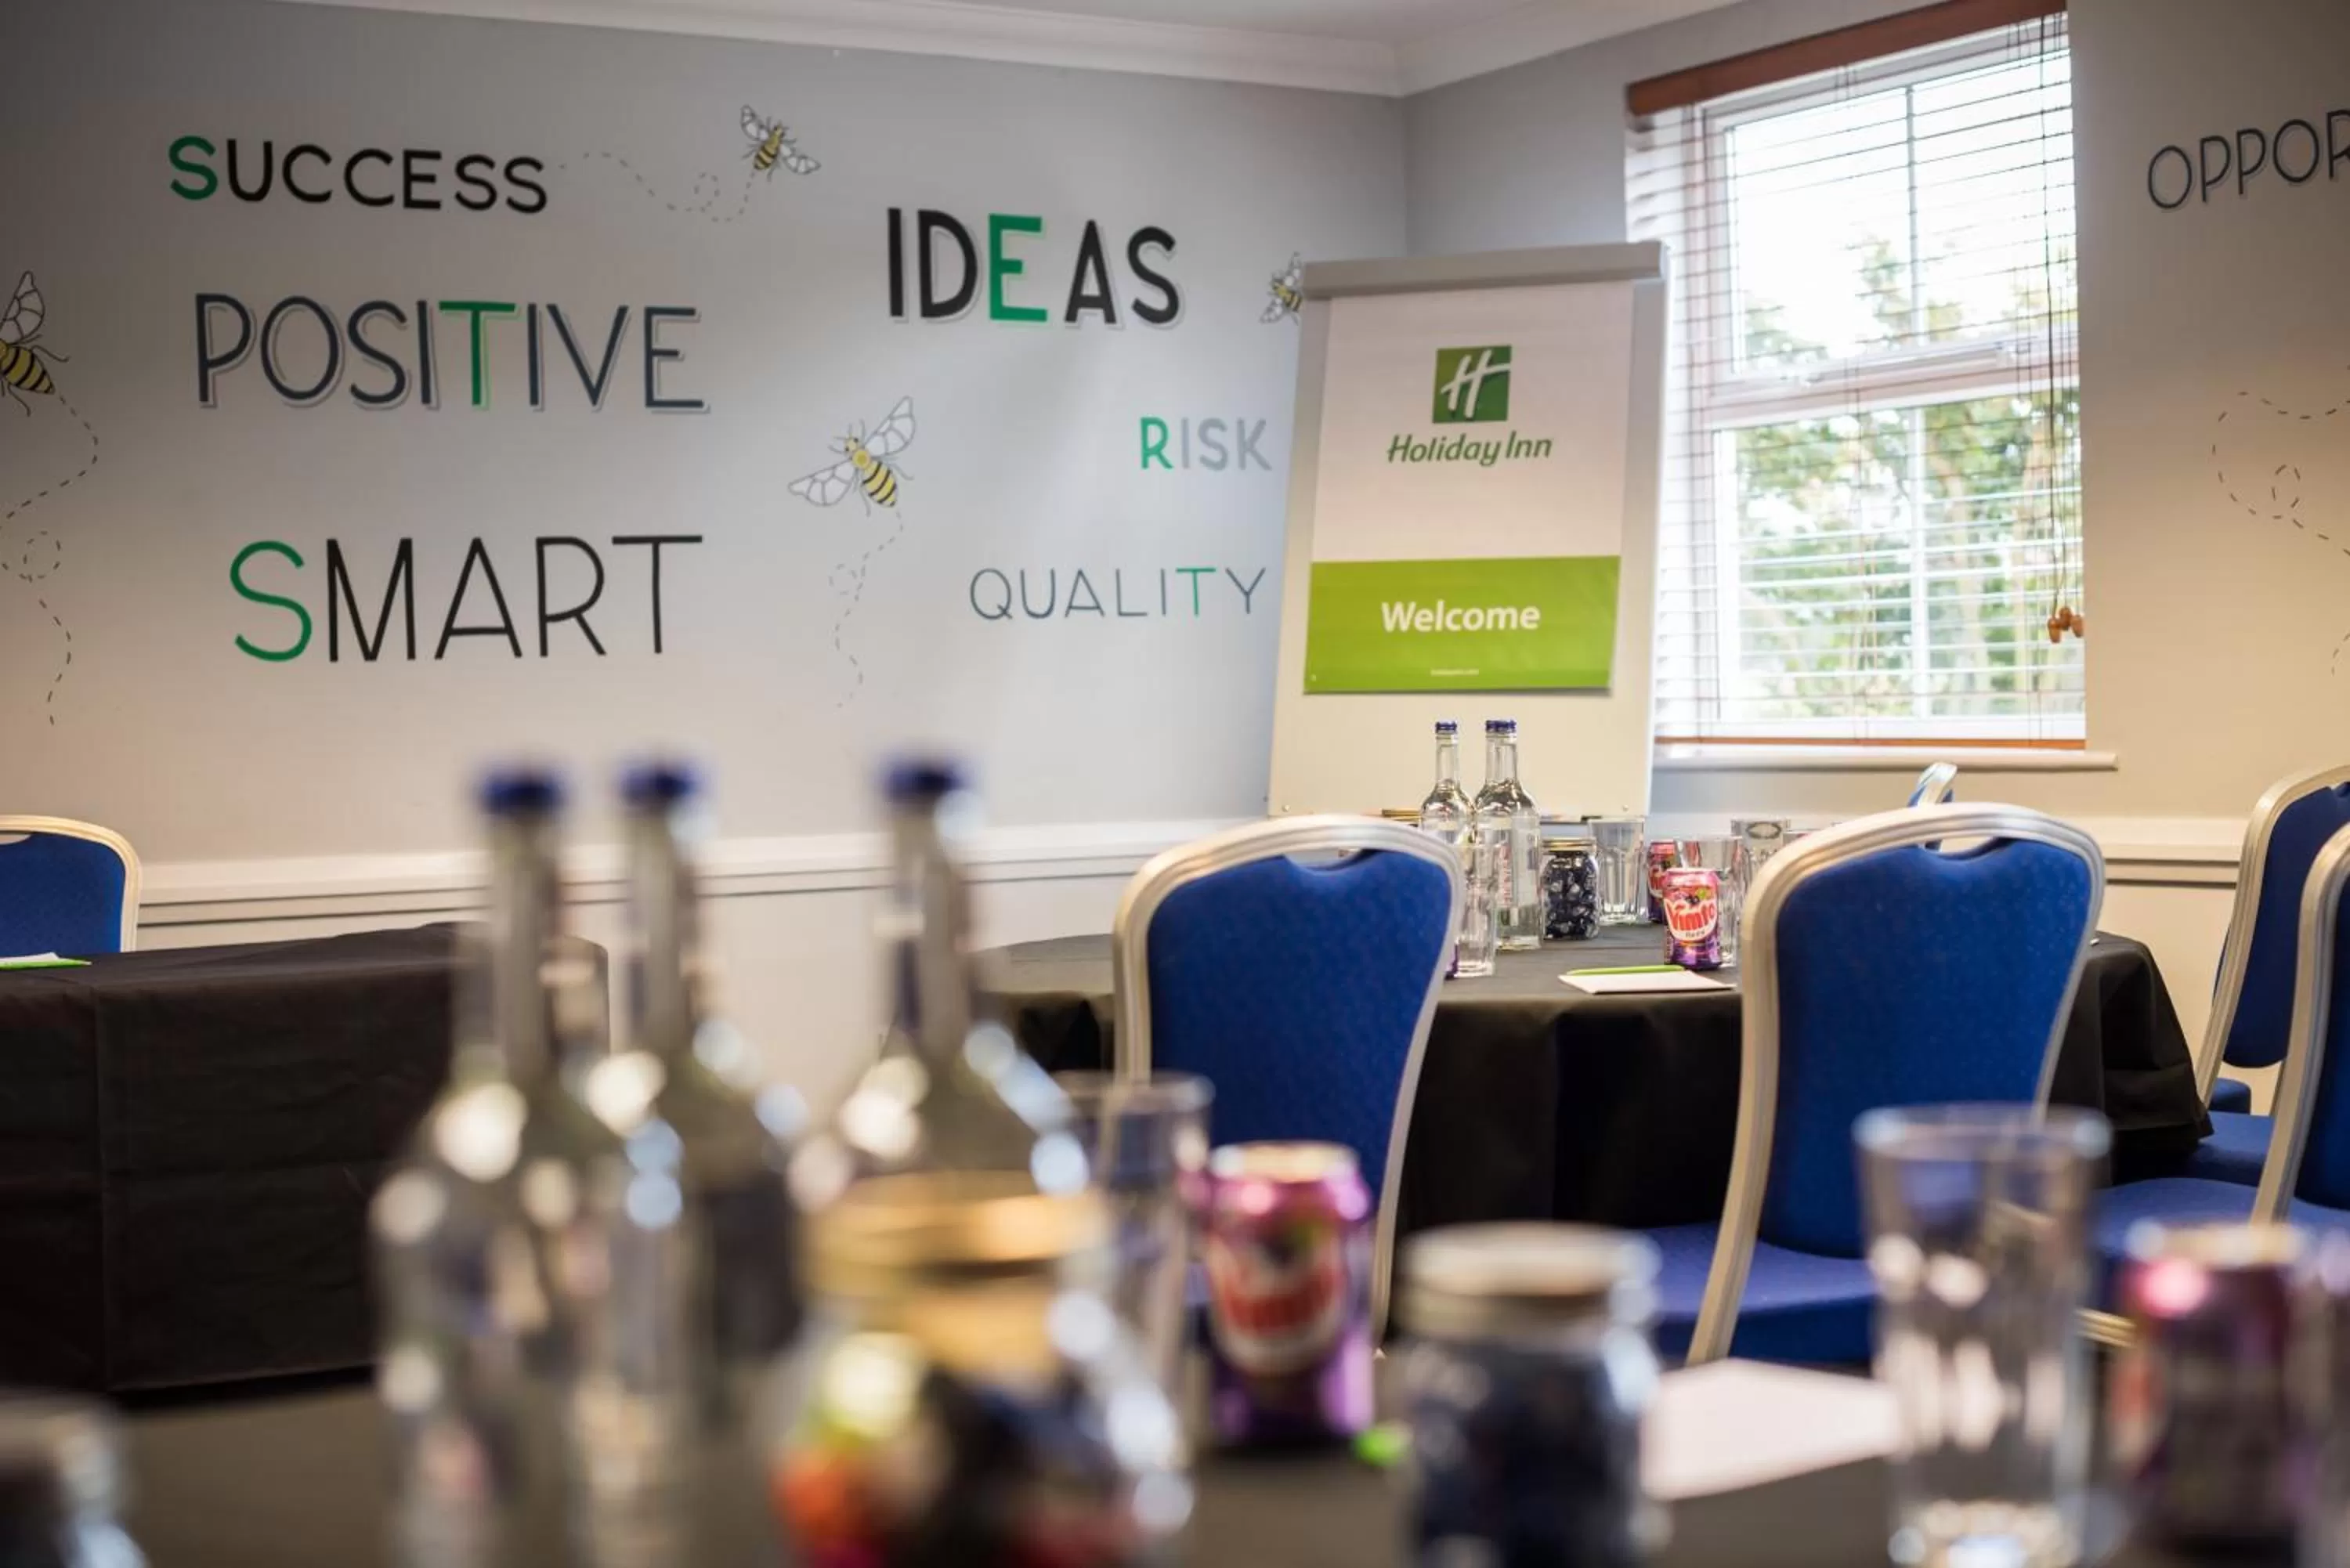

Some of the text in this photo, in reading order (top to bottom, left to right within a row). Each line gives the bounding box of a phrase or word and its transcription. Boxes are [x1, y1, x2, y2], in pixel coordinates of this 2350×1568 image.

[168, 135, 548, 214] SUCCESS
[2147, 109, 2350, 210] OPPOR
[887, 207, 1185, 329] IDEAS
[194, 292, 709, 413] POSITIVE
[1140, 416, 1272, 471] RISK
[1387, 429, 1553, 468] Holiday Inn
[230, 535, 703, 663] SMART
[969, 566, 1267, 620] QUALITY
[1380, 599, 1541, 633] Welcome
